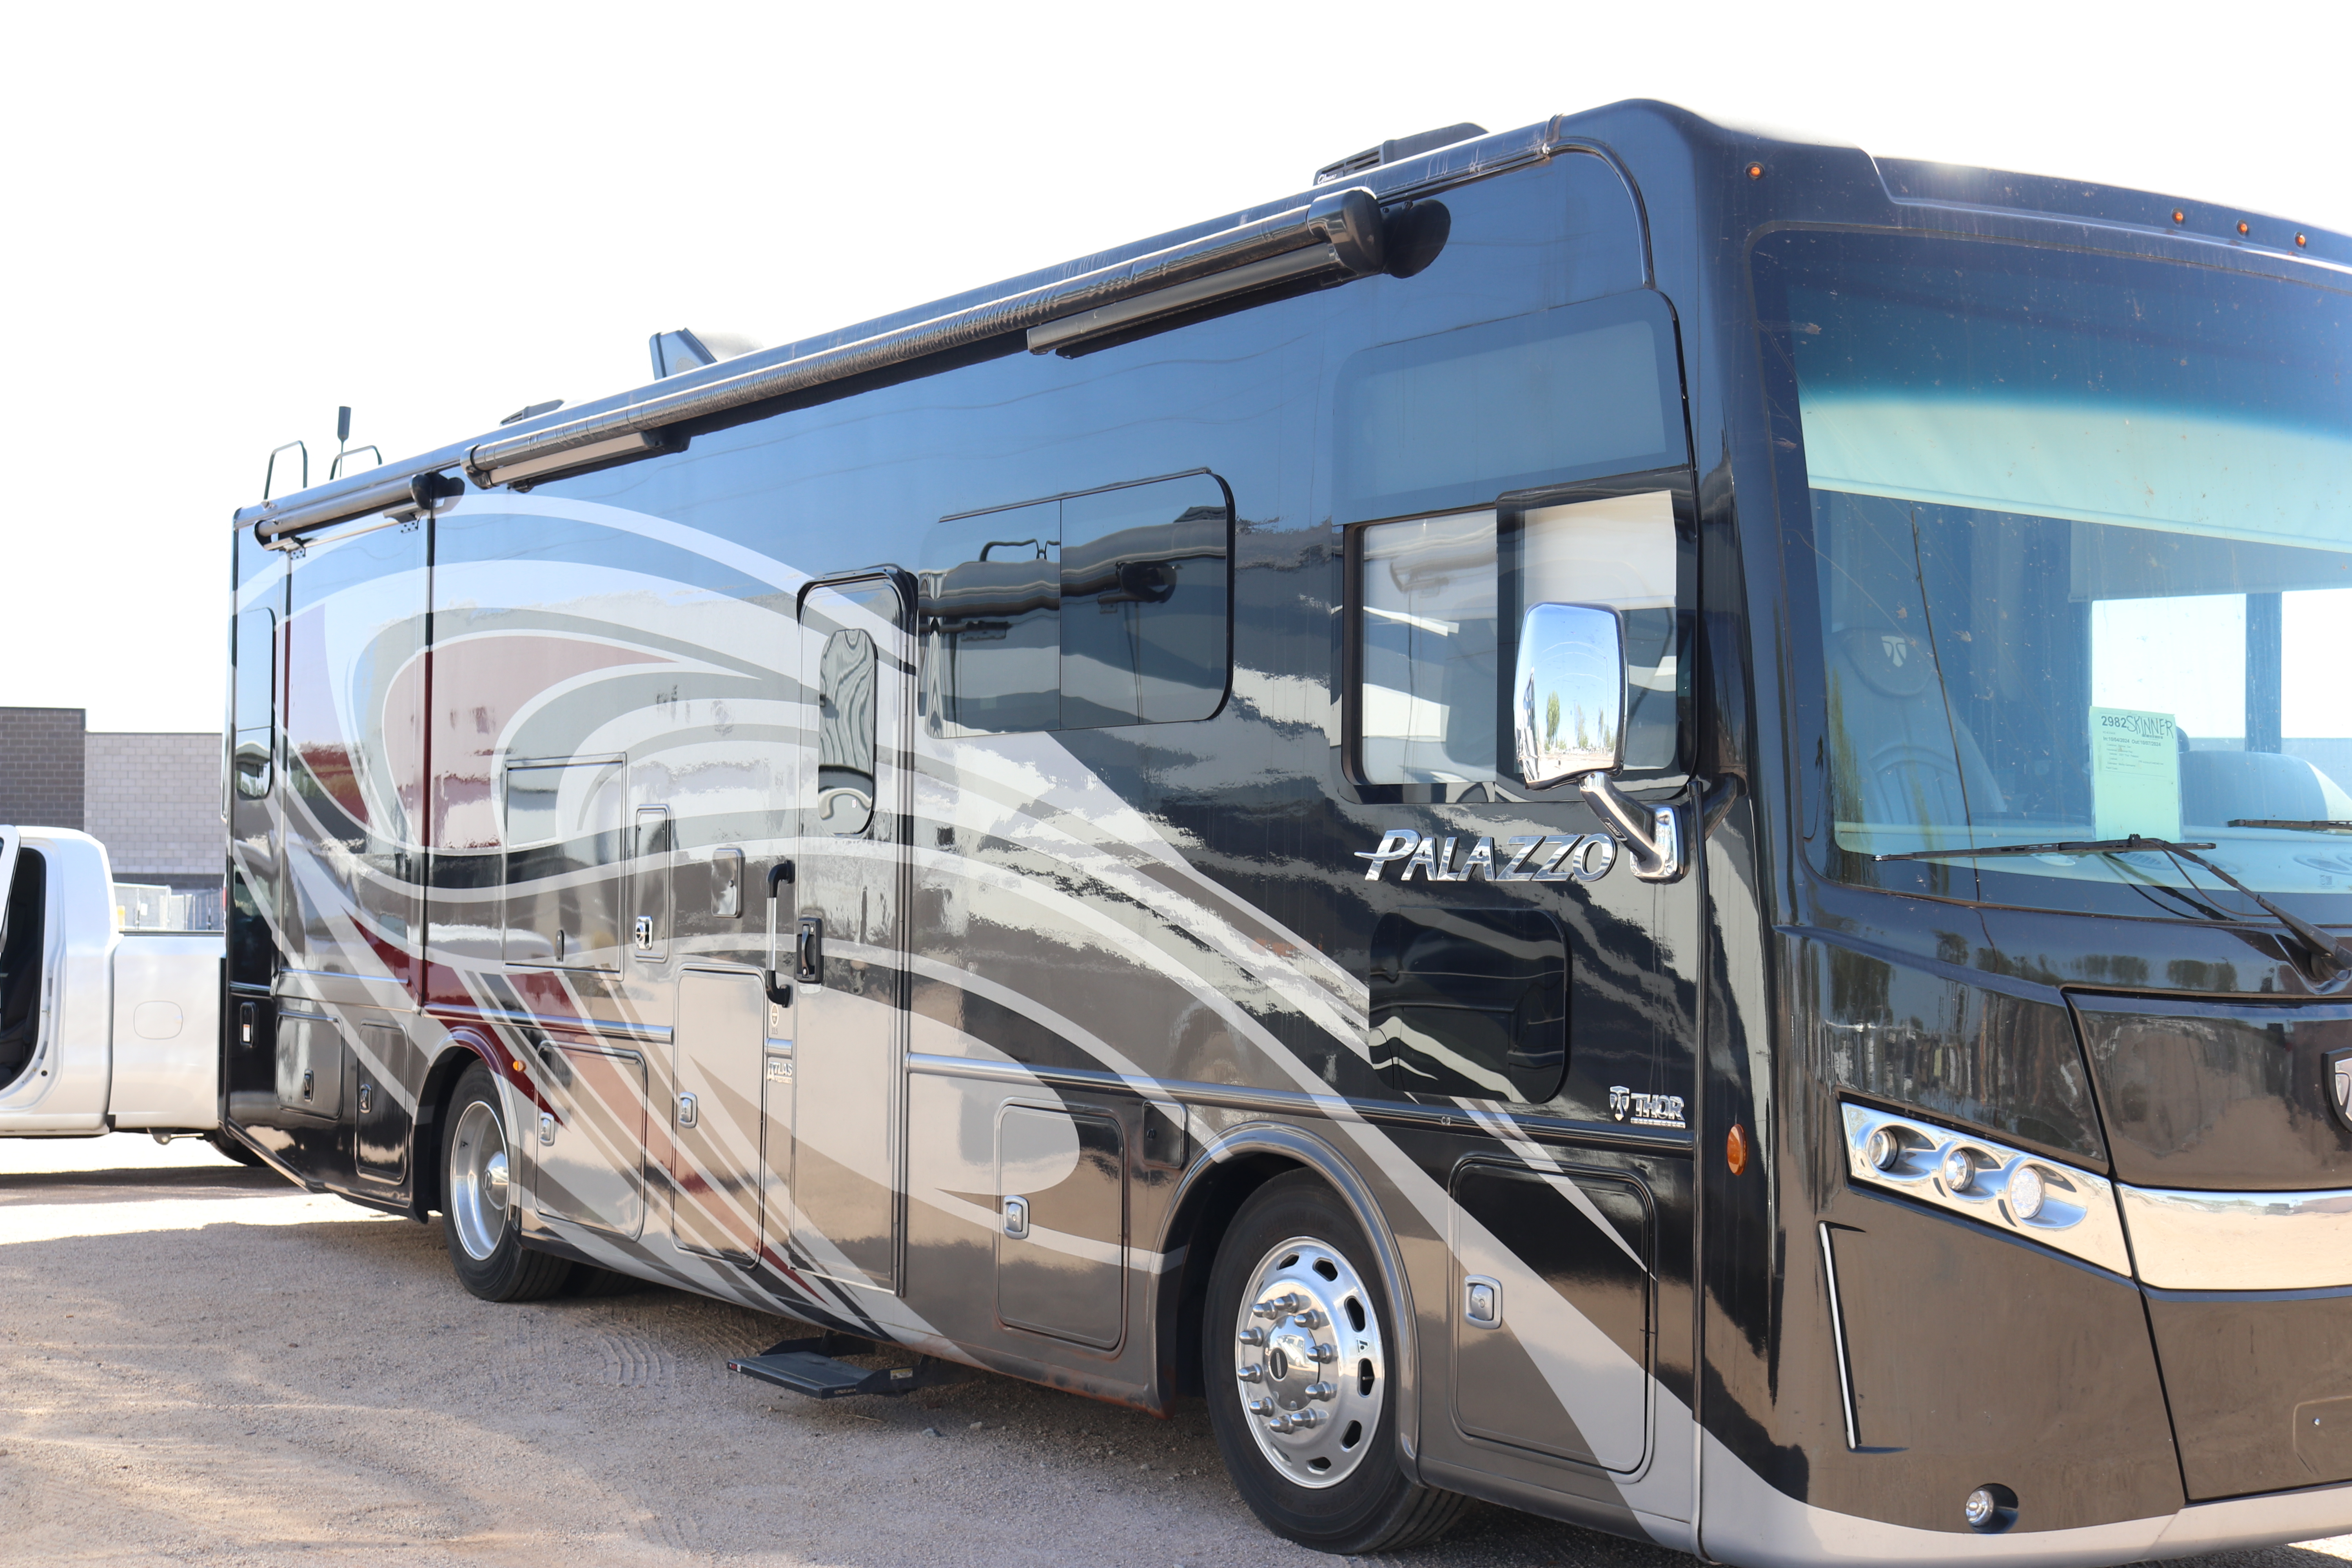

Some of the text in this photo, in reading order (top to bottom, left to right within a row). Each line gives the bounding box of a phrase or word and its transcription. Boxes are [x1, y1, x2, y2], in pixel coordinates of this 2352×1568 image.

[2101, 716, 2127, 728] 2982
[2126, 715, 2174, 739] SKINNER
[1354, 829, 1618, 882] PALAZZO
[766, 1062, 792, 1082] ATLAS
[1631, 1093, 1685, 1121] THOR
